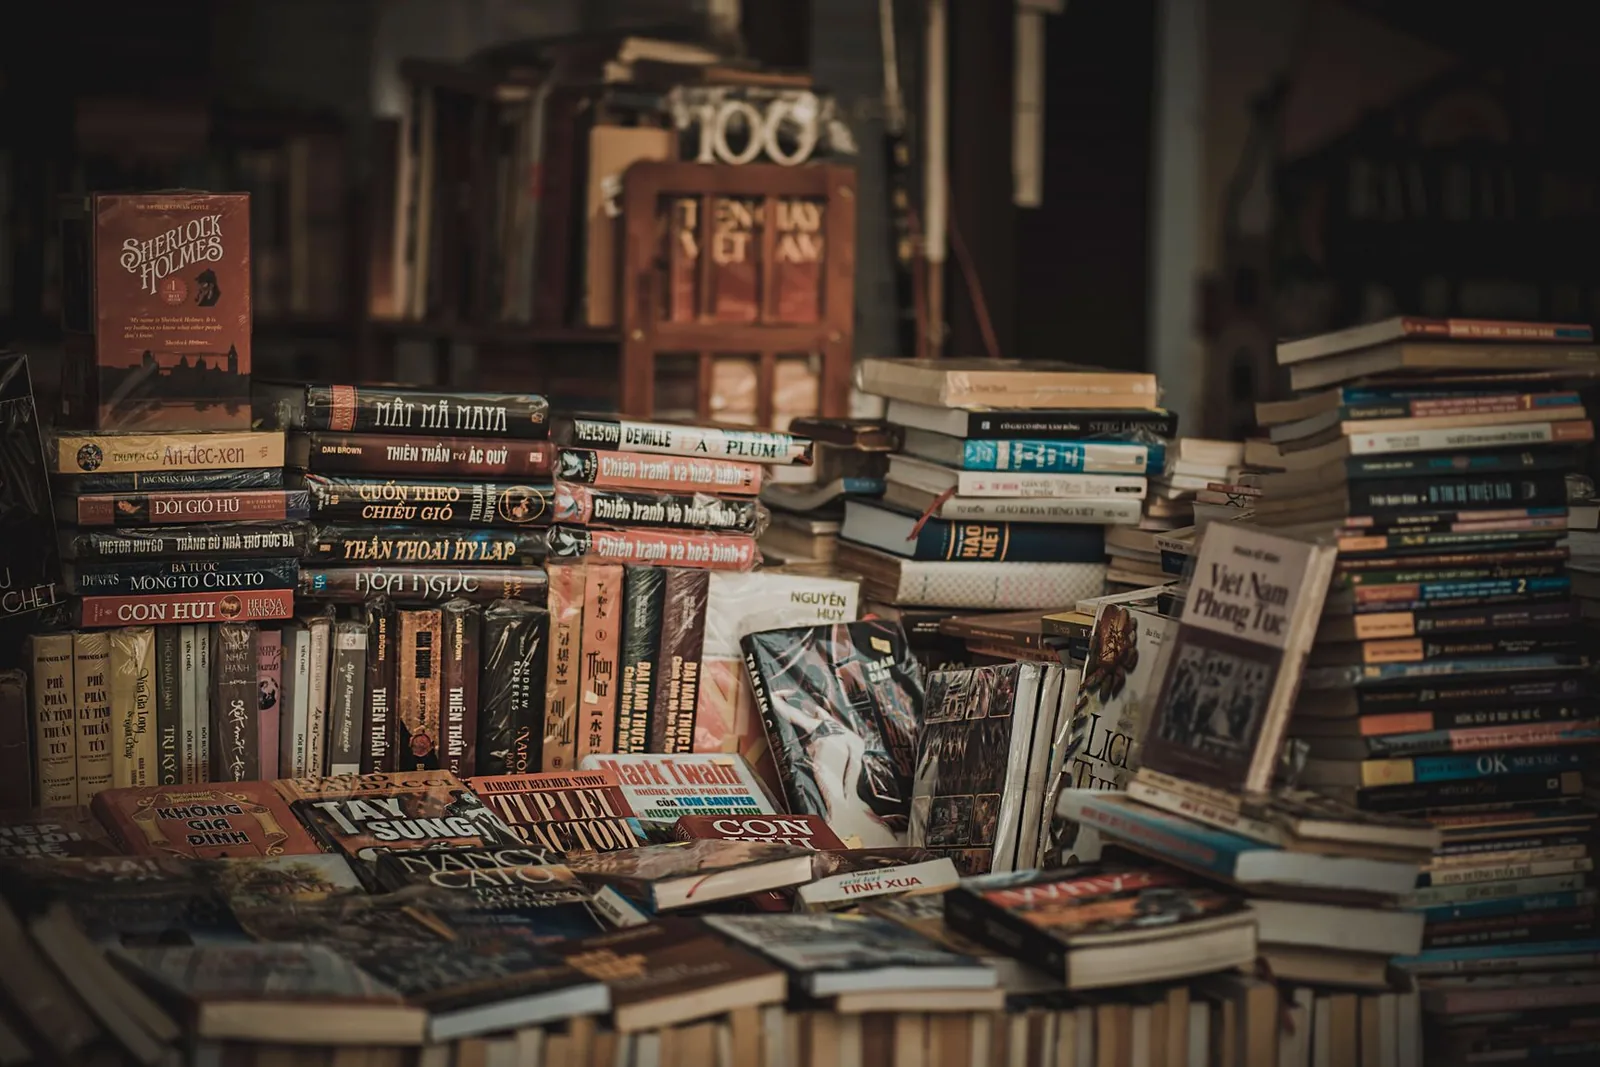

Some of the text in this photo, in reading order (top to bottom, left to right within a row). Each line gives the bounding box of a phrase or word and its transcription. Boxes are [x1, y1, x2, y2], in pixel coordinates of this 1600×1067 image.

[120, 214, 222, 273] SHERLOCK
[141, 236, 223, 295] HOLMES
[420, 399, 450, 429] MÃ
[455, 405, 508, 432] MAYA
[322, 446, 362, 455] DAN BROWN
[578, 422, 621, 443] NELSON
[626, 427, 672, 447] DEMILLE
[726, 440, 777, 458] PLUM
[386, 444, 418, 462] THIÊN
[421, 443, 450, 463] THẦN
[453, 450, 466, 461] và
[639, 461, 670, 481] tranh
[359, 480, 408, 501] CUỐN
[413, 486, 460, 502] THEO
[186, 498, 213, 514] GIÓ
[217, 496, 239, 513] HÚ
[362, 501, 453, 521] CHIỀU GIÓ
[469, 484, 483, 522] MITCHELL
[482, 483, 496, 524] MARGARET
[632, 500, 664, 522] tranh
[666, 504, 681, 523] và
[99, 539, 164, 554] VICTOR HUYGO
[635, 540, 668, 559] tranh
[670, 543, 685, 560] và
[1245, 572, 1289, 606] Nam
[117, 604, 167, 621] CON
[247, 597, 282, 609] HELENA
[247, 606, 287, 617] MNISZEK
[1193, 589, 1251, 633] Phong
[817, 608, 845, 620] HUY
[455, 634, 463, 661] BROWN
[46, 674, 64, 689] PHÊ
[87, 672, 104, 687] PHÊ
[511, 661, 521, 711] ROBERTS
[521, 661, 530, 709] ANDREW
[44, 692, 68, 706] PHÁN
[84, 688, 108, 703] PHÁN
[449, 687, 467, 722] THIÊN
[634, 684, 649, 710] NAM
[679, 684, 695, 711] NAM
[40, 709, 52, 722] LÝ
[79, 706, 91, 720] LÝ
[371, 687, 390, 757] THIÊN THẦN
[162, 725, 175, 749] TRI
[448, 725, 467, 757] THẦN
[598, 759, 743, 786] Mark Twain
[1476, 754, 1508, 774] OK
[484, 775, 607, 792] HARRIET BEECHER STOWE
[155, 803, 244, 820] KHÔNG
[657, 796, 757, 807] CỦA TOM SAWYER
[186, 818, 232, 831] GIA
[312, 798, 406, 834] TAY
[712, 819, 814, 836] CON
[400, 848, 548, 874] NANCY
[429, 864, 554, 889] CATO
